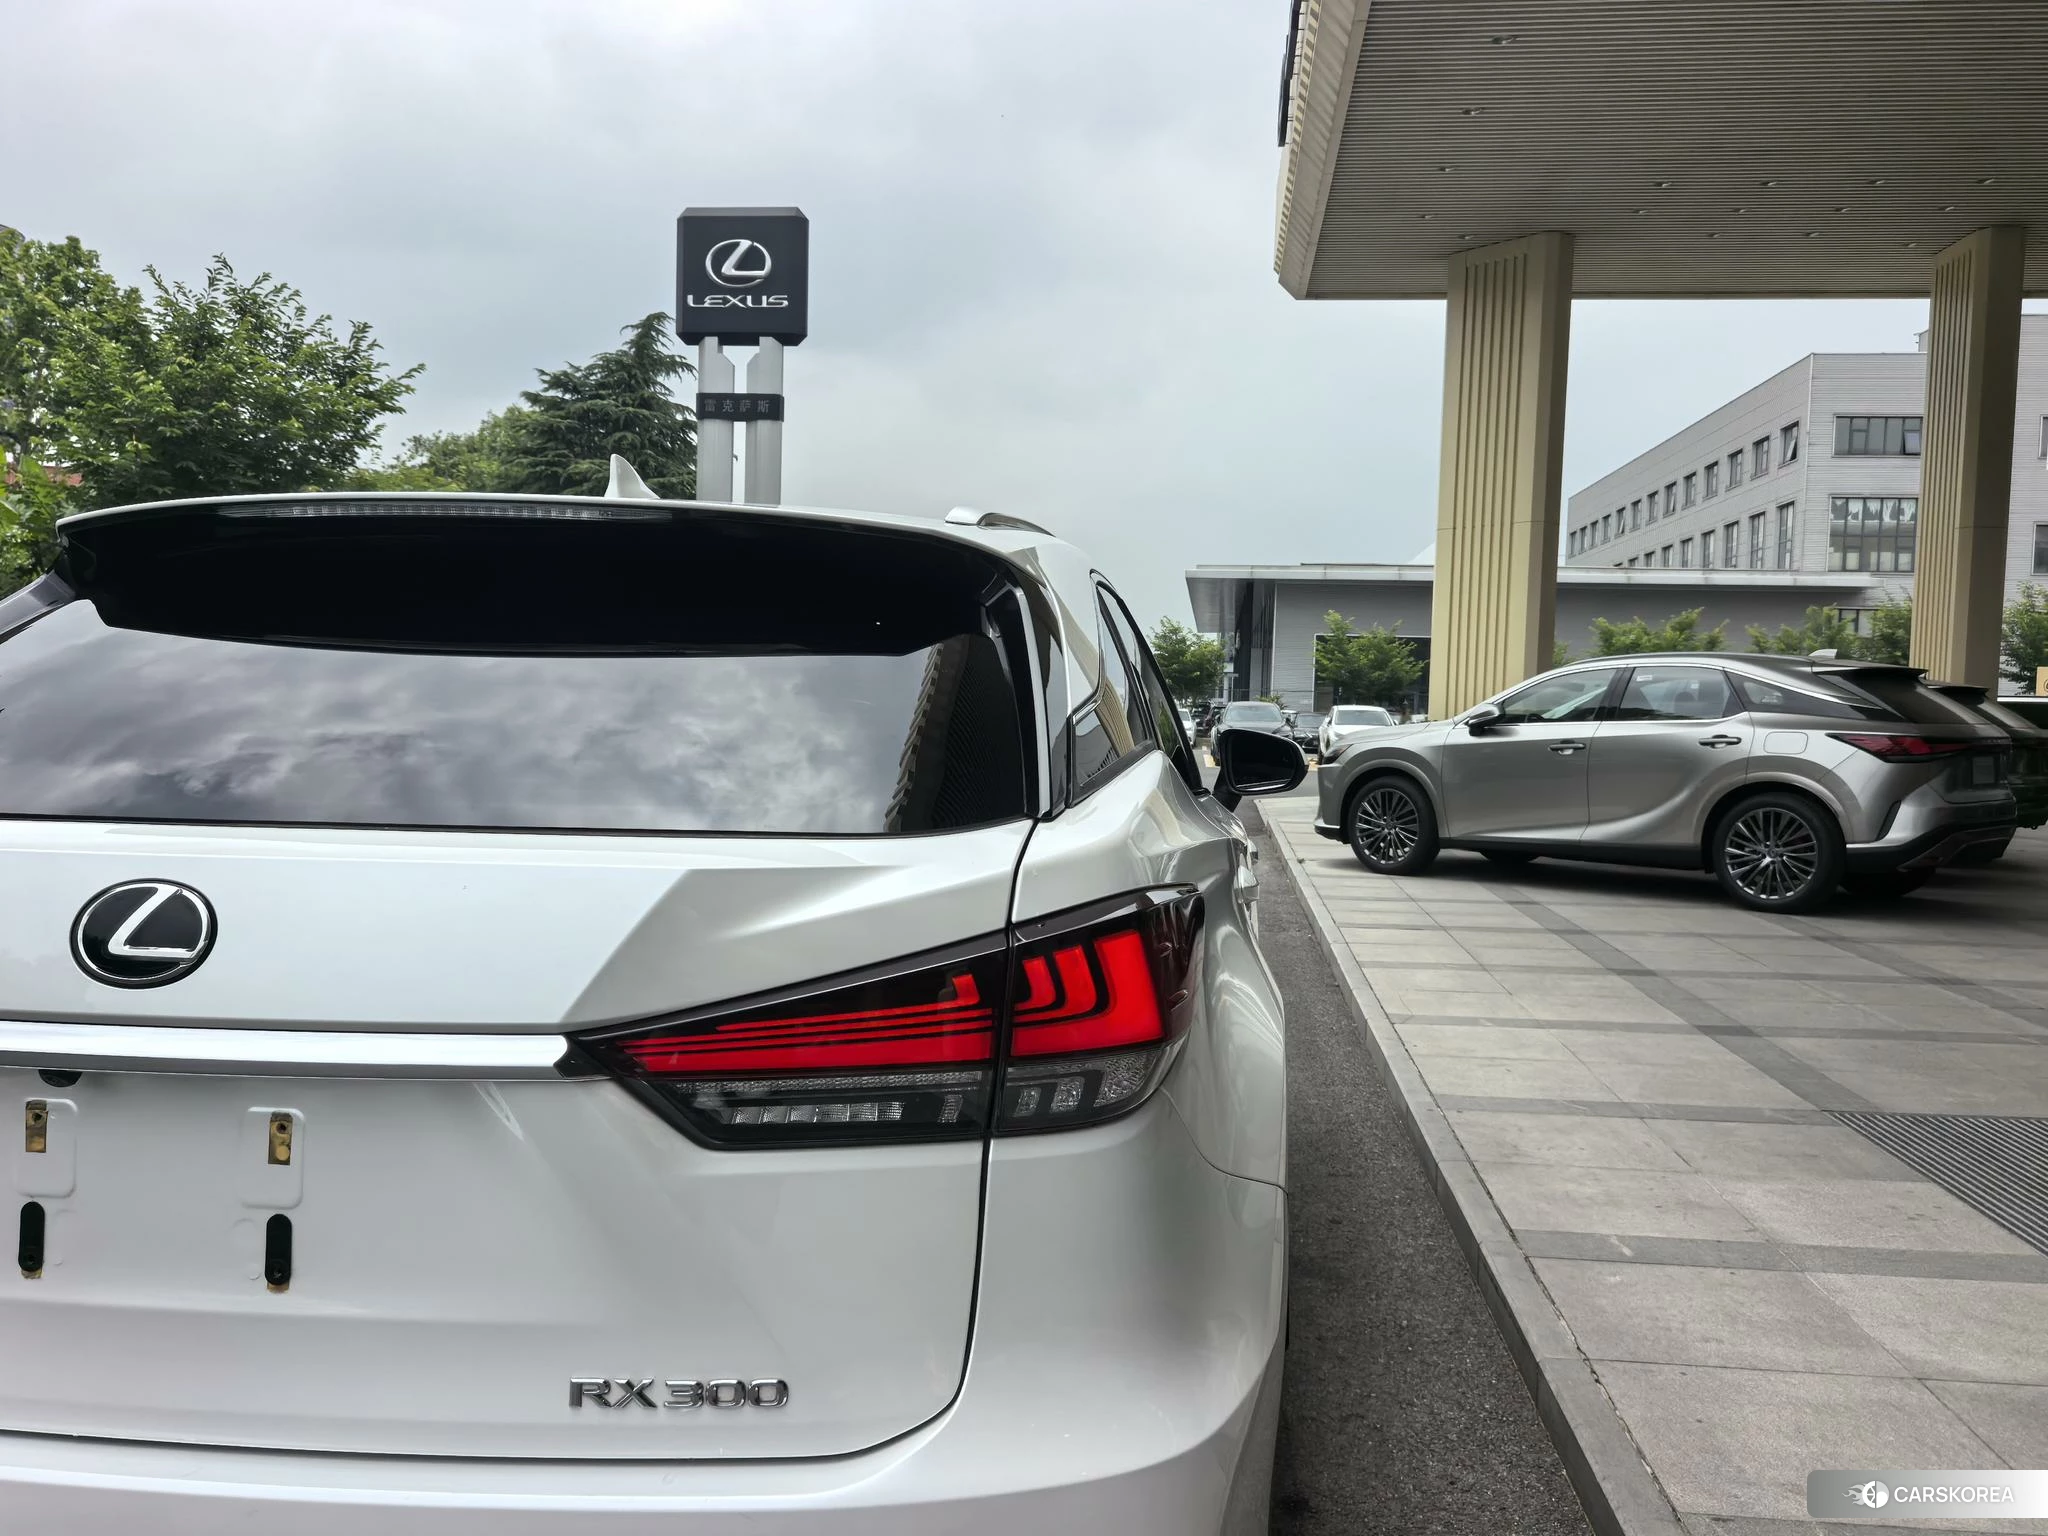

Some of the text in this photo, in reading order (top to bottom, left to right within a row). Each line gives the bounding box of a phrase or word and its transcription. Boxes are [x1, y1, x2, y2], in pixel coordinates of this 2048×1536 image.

[687, 294, 789, 308] LEXUS
[704, 399, 770, 413] 雷克萨斯
